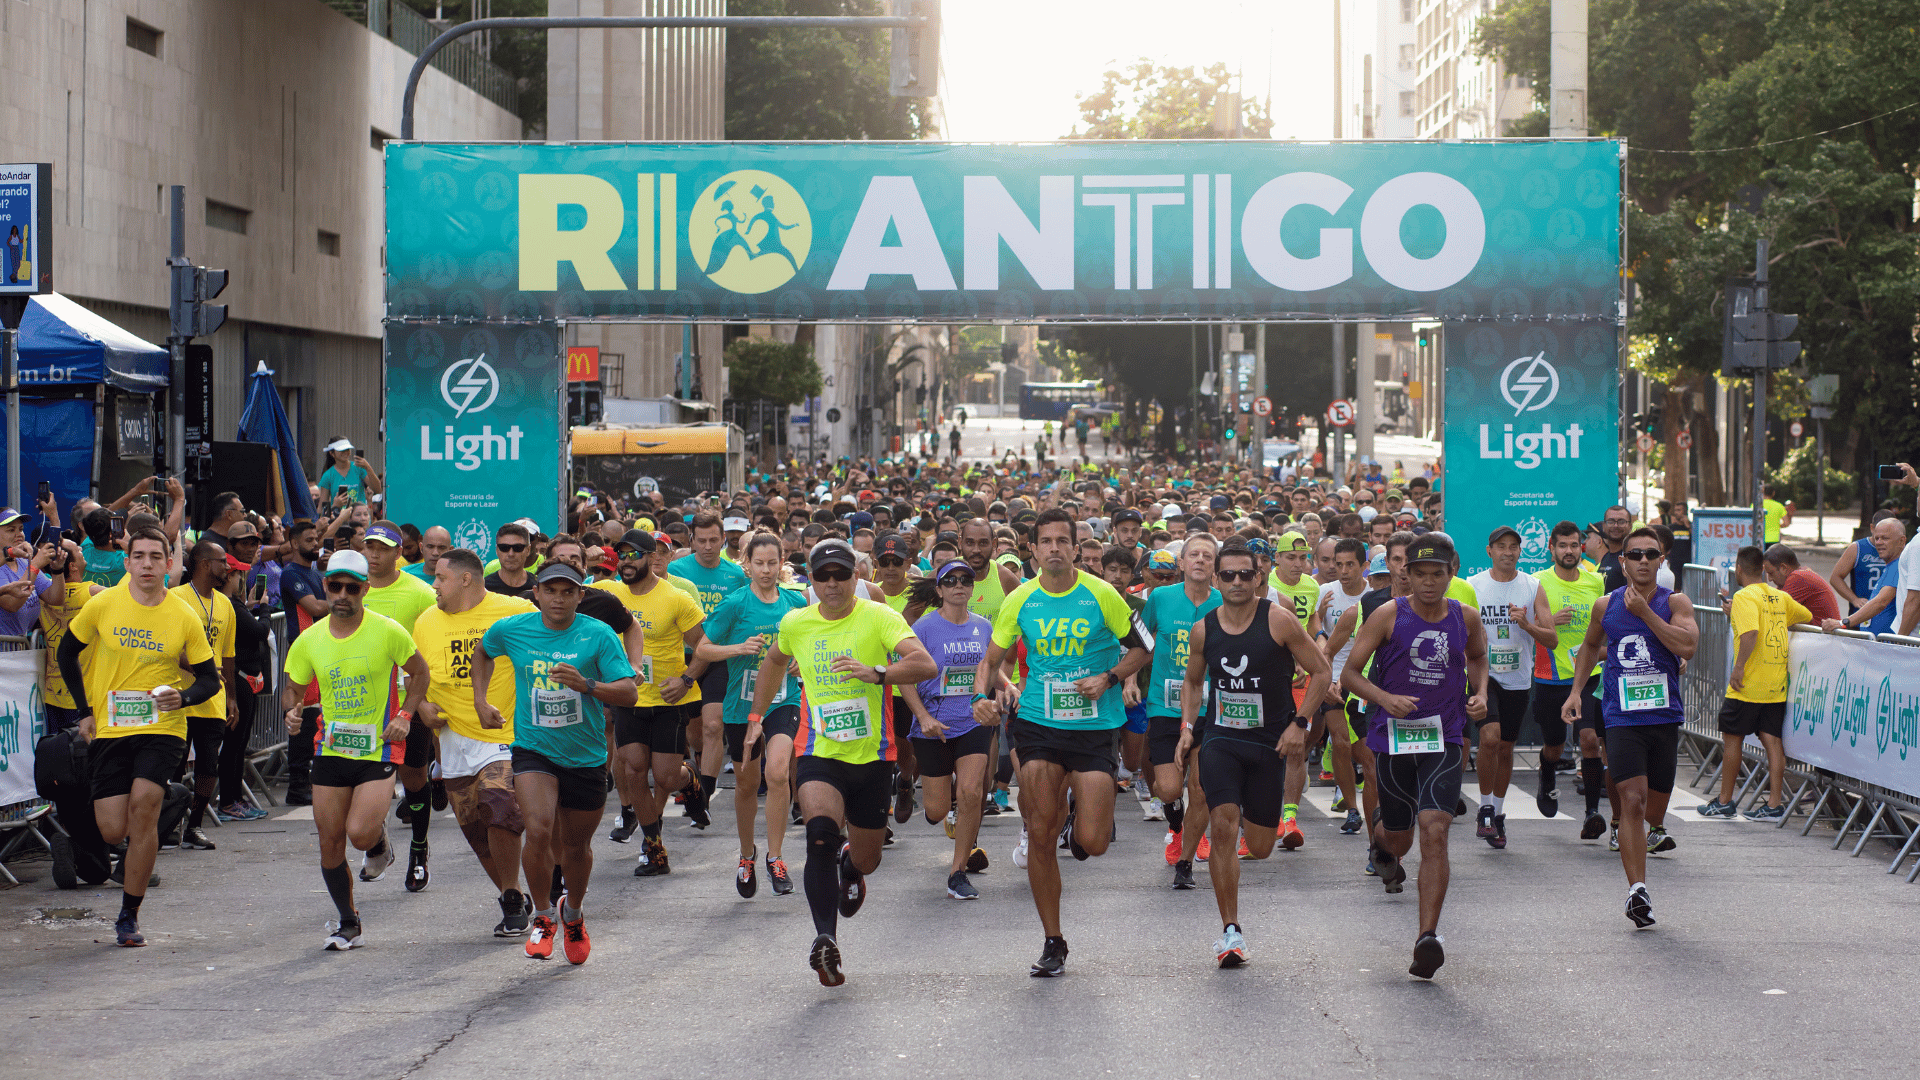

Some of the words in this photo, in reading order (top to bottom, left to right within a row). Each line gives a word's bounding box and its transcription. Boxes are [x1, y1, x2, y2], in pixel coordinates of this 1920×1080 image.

[518, 170, 812, 294] RIO
[826, 171, 1486, 292] ANTIGO
[421, 425, 523, 471] Light
[1480, 424, 1584, 469] Light
[445, 501, 472, 509] Esporte
[1504, 499, 1532, 507] Esporte
[113, 627, 153, 640] LONGE
[1033, 617, 1091, 638] VEG
[119, 638, 164, 652] VIDADE
[815, 639, 827, 650] SE
[943, 642, 983, 654] MULHER
[1035, 637, 1087, 656] RUN
[1496, 654, 1514, 664] 845
[329, 666, 342, 680] SE
[949, 674, 974, 684] 4489
[331, 675, 368, 690] CUIDAR
[333, 687, 358, 700] VALE
[360, 686, 368, 695] A
[1634, 687, 1657, 699] 573
[334, 698, 365, 710] PENA!
[544, 702, 568, 715] 996
[1060, 696, 1083, 708] 586
[1804, 675, 1829, 736] Light
[118, 703, 149, 715] 4029
[1224, 705, 1252, 717] 4281
[1844, 682, 1870, 748] Light
[828, 713, 860, 730] 4537
[1892, 691, 1920, 761] Light
[336, 735, 367, 748] 4369
[1405, 730, 1430, 741] 570
